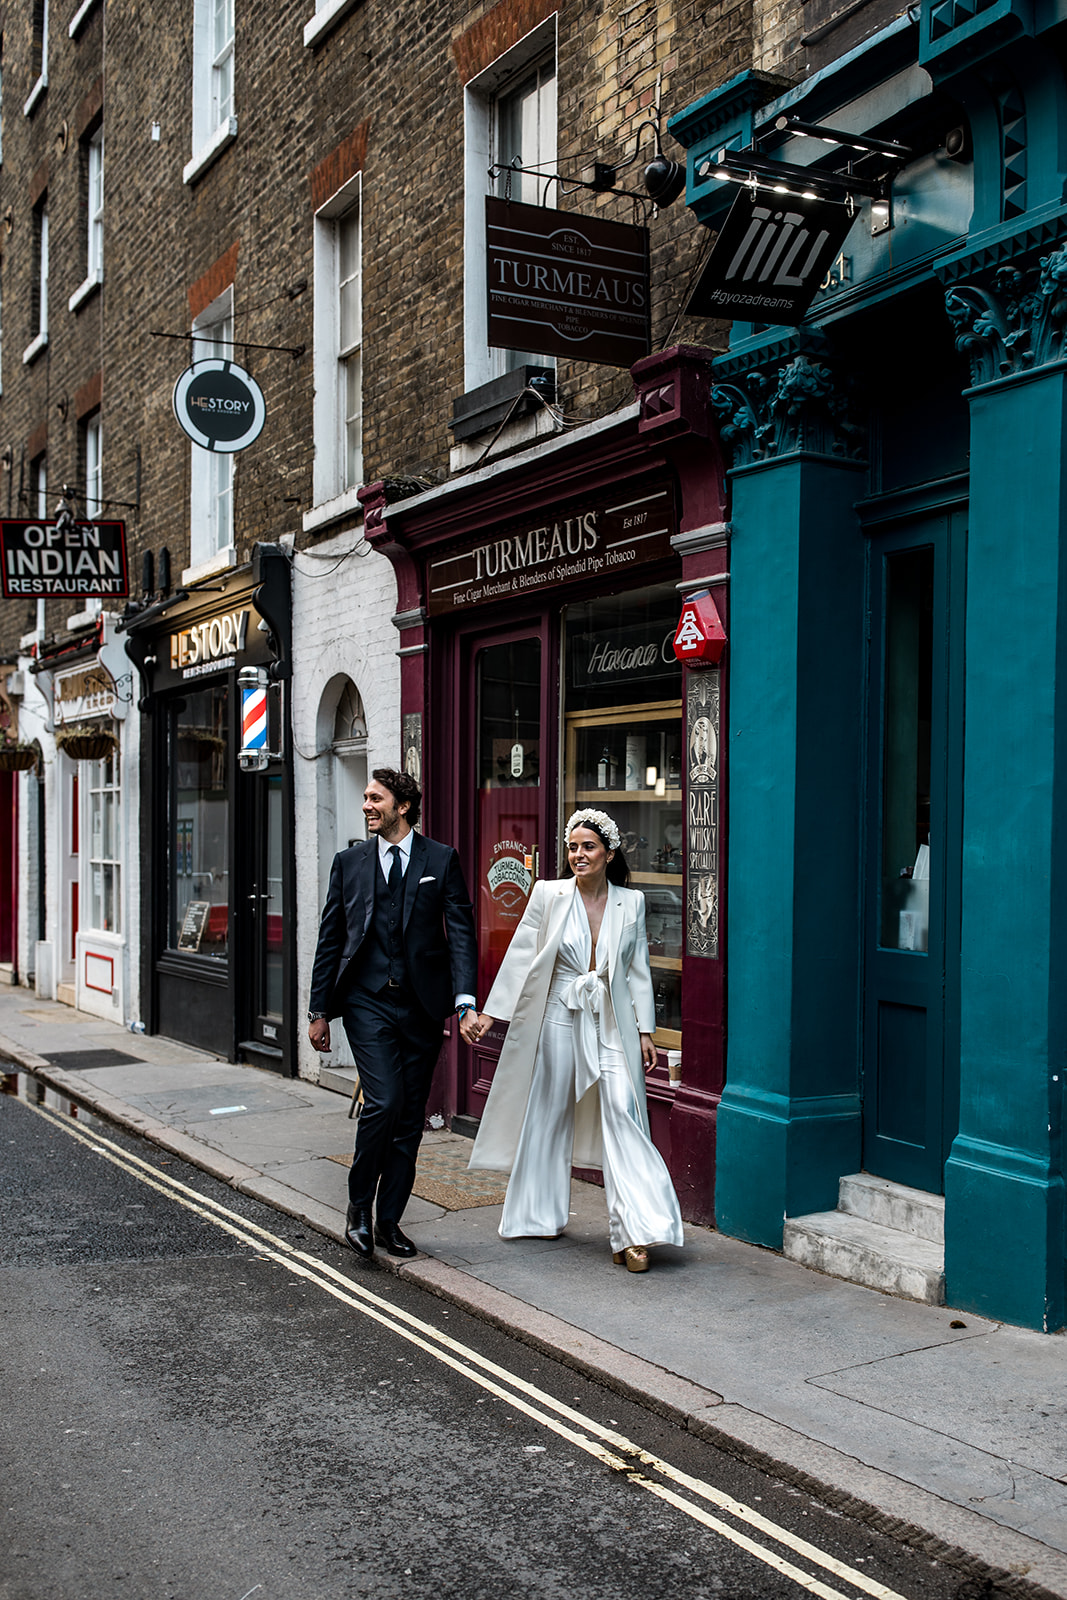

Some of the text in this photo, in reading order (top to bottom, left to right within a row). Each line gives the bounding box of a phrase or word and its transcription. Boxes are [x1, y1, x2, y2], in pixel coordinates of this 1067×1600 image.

[551, 241, 592, 257] SINCE 1817
[493, 258, 645, 307] TURMEAUS
[491, 294, 507, 304] FINE
[507, 297, 529, 306] CIGAR
[530, 300, 568, 313] MERCHANT
[575, 308, 609, 320] BLENDERS
[710, 289, 795, 309] #gyozadreams
[557, 323, 589, 334] TOBACCO
[565, 316, 580, 324] PIPE
[191, 396, 250, 412] HESTORY
[633, 511, 648, 526] 1817
[24, 525, 100, 548] OPEN
[472, 511, 598, 581] TURMEAUS
[7, 549, 120, 575] INDIAN
[8, 578, 123, 593] RESTAURANT
[453, 549, 636, 605] Fine Cigar Merchant & Blenders of Splendid Pipe Tobacco
[170, 610, 248, 670] HESTORY
[587, 641, 658, 674] Havana
[690, 791, 716, 826] RARE
[493, 840, 528, 855] ENTRANCE
[690, 827, 716, 851] WHISKY
[494, 860, 525, 877] TURMEAUS
[690, 852, 716, 870] SPECIALIST
[490, 871, 529, 890] TOBACCONIST
